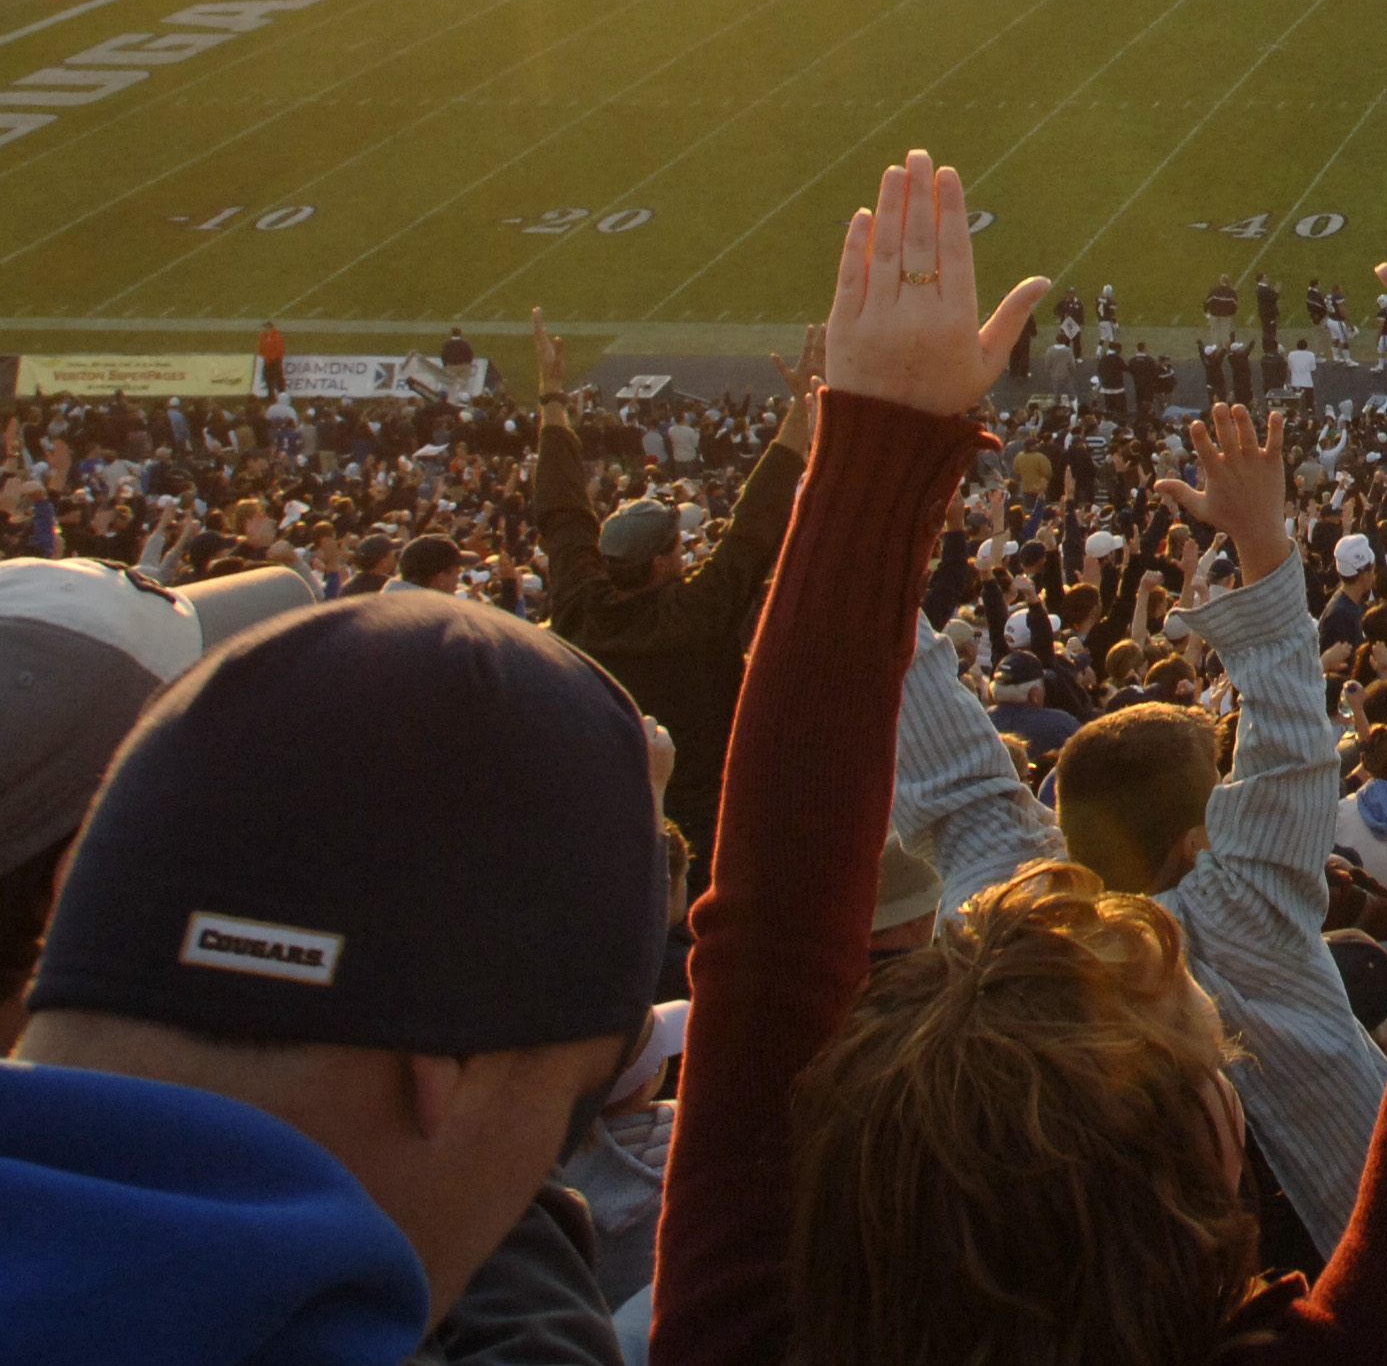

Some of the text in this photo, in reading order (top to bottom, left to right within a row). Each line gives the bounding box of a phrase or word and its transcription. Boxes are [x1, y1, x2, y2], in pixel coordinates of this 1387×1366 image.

[520, 208, 654, 234] 20
[1219, 212, 1346, 238] 40
[284, 362, 368, 375] DIAMOND
[285, 378, 348, 391] RENTAL
[198, 928, 325, 968] COUGARS
